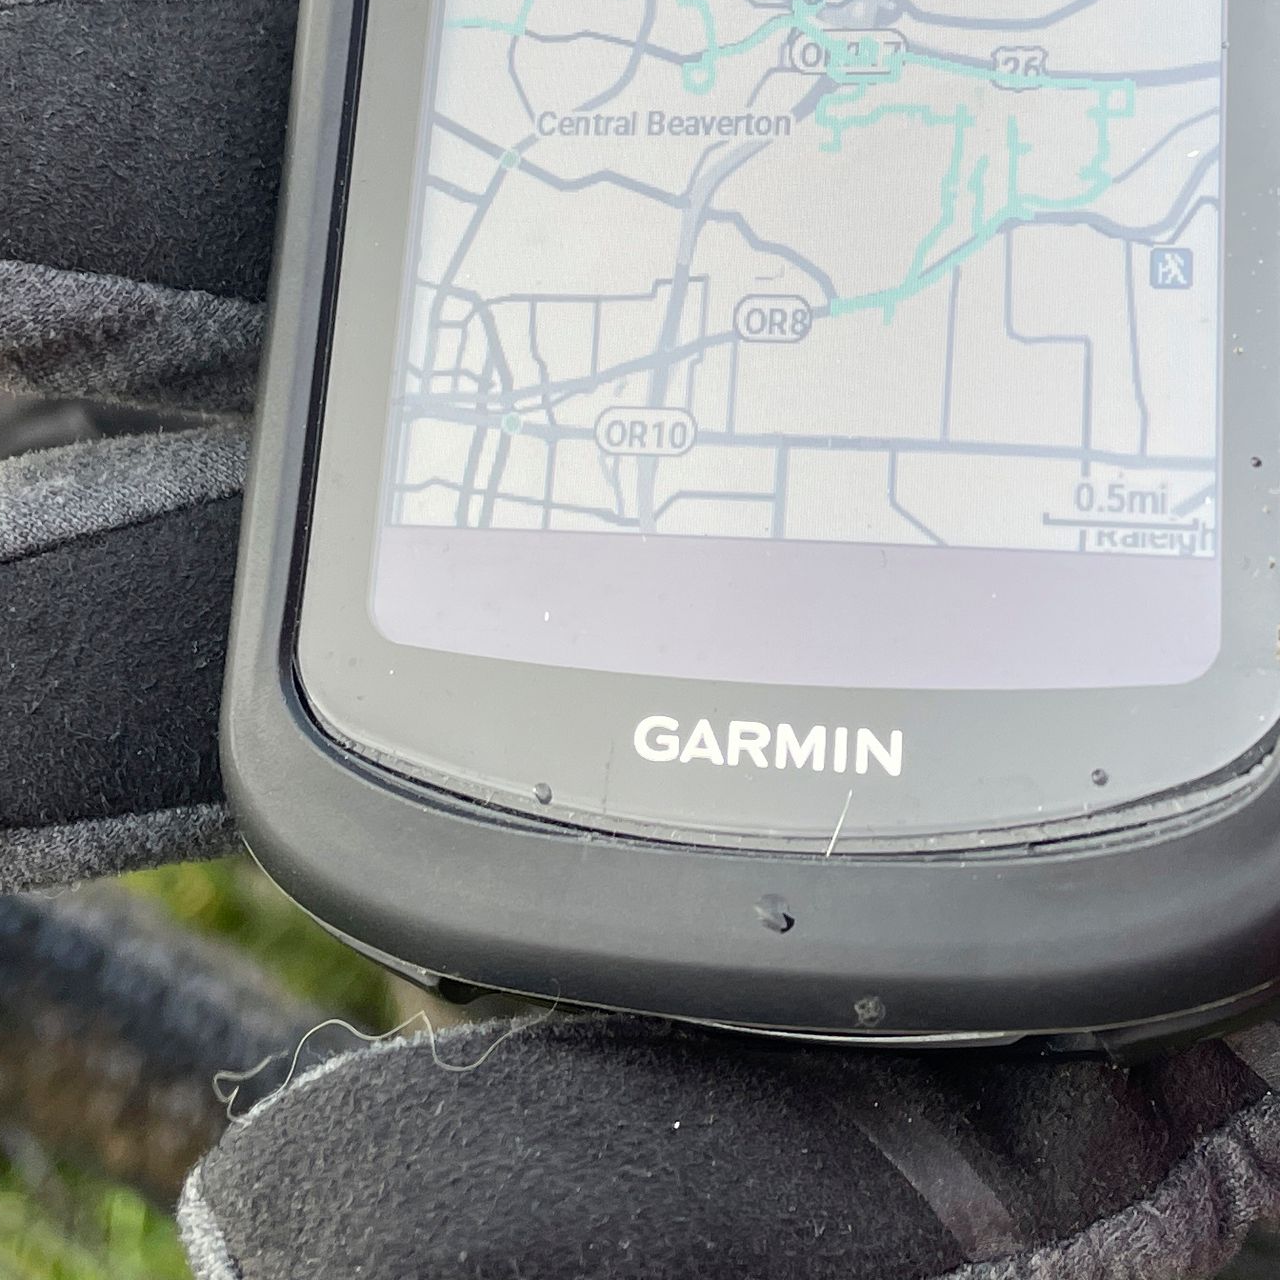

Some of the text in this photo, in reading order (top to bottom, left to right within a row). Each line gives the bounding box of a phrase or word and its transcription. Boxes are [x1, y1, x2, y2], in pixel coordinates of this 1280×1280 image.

[537, 110, 792, 137] Central Beaverton
[745, 307, 809, 336] OR8
[606, 419, 688, 449] OR10
[1076, 482, 1169, 515] 0.5mi
[634, 715, 903, 777] GARMIN
